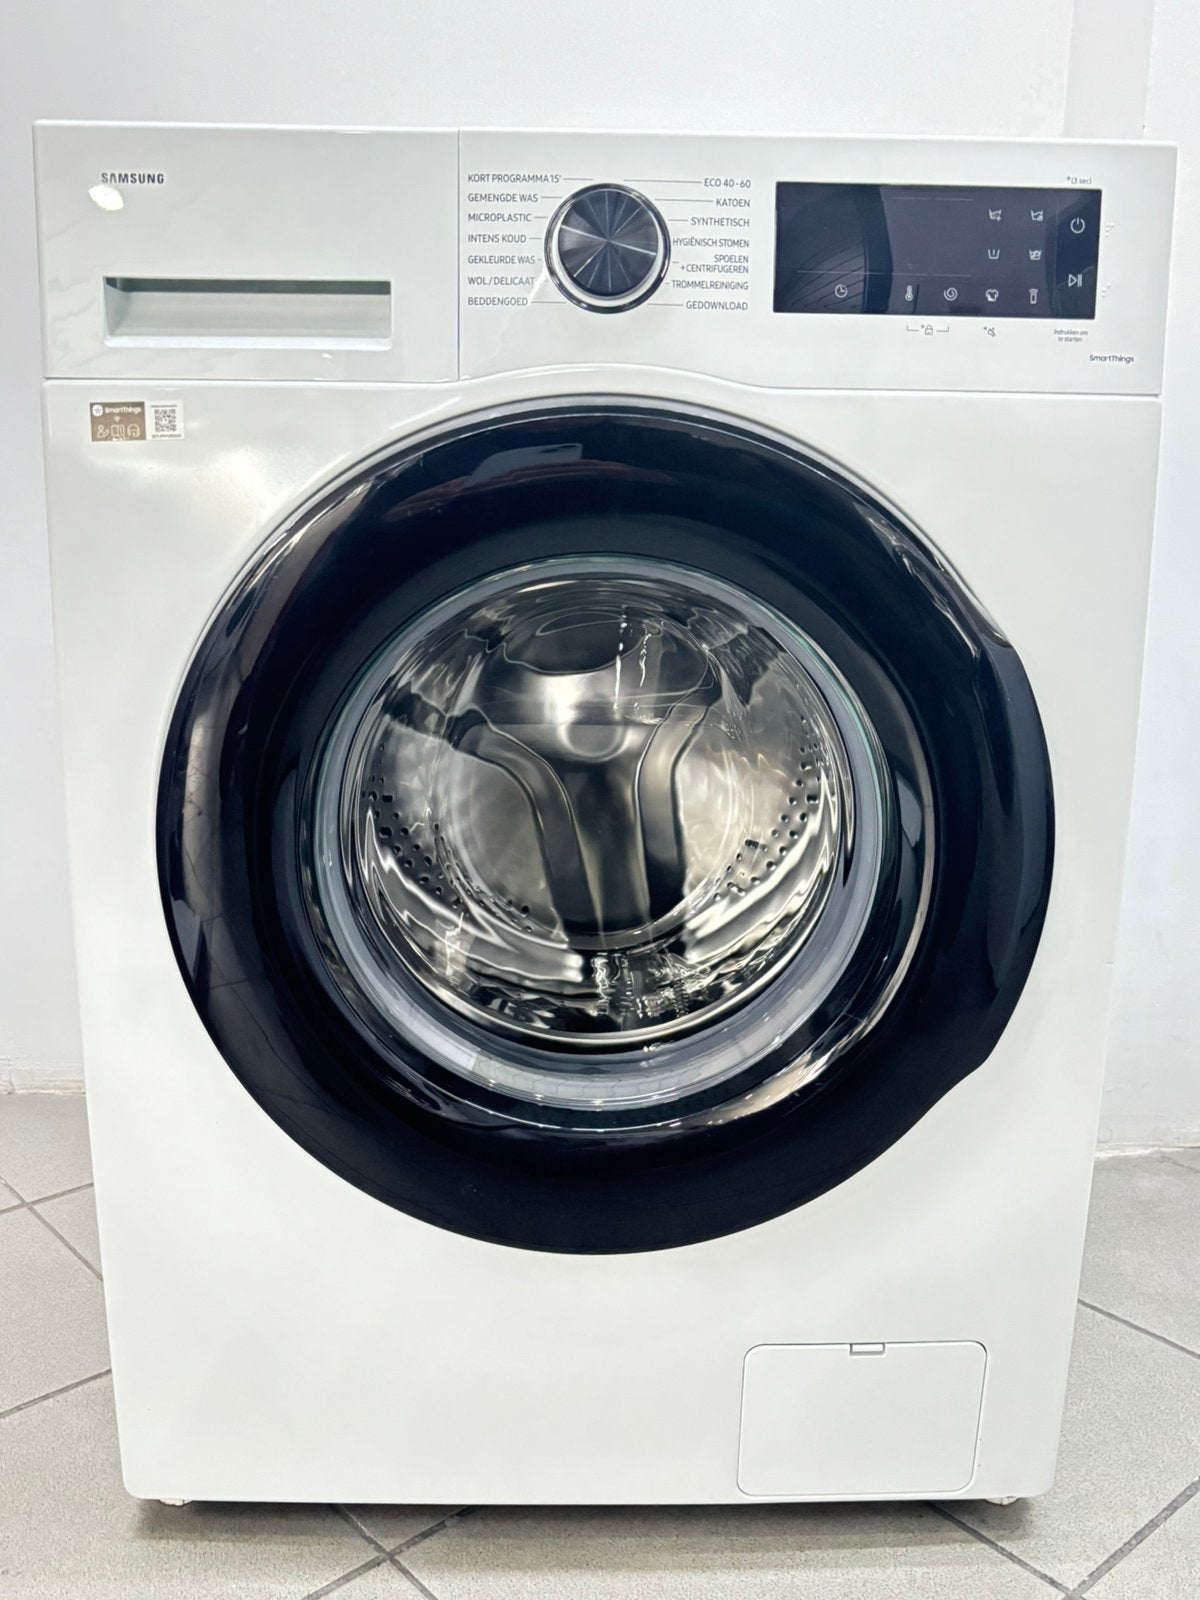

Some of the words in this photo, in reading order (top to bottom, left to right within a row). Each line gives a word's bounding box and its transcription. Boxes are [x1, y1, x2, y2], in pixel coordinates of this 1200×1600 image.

[101, 172, 164, 184] SAMSUNG
[468, 174, 490, 182] KORT
[491, 174, 550, 183] PROGRAMMA
[704, 178, 721, 187] ECO
[468, 193, 517, 202] GEMENGDE
[519, 194, 538, 202] WAS
[716, 198, 750, 207] KATOEN
[468, 213, 531, 222] MICROPLASTIC
[691, 217, 750, 227] SYNTHETISCH
[468, 234, 500, 242] INTENS
[501, 234, 527, 242] KOUD
[673, 236, 717, 247] HYGIËNISCH
[719, 239, 749, 248] STOMEN
[468, 255, 516, 264] GEKLEURDE
[517, 256, 535, 264] WAS
[714, 255, 749, 263] SPOELEN
[681, 264, 749, 273] +CENTRIFUGEREN
[672, 280, 748, 290] TROMMELREINIGING
[468, 297, 528, 306] BEDDENGOED
[686, 300, 748, 310] GEDOWNLOAD
[1089, 354, 1135, 364] SmartThings
